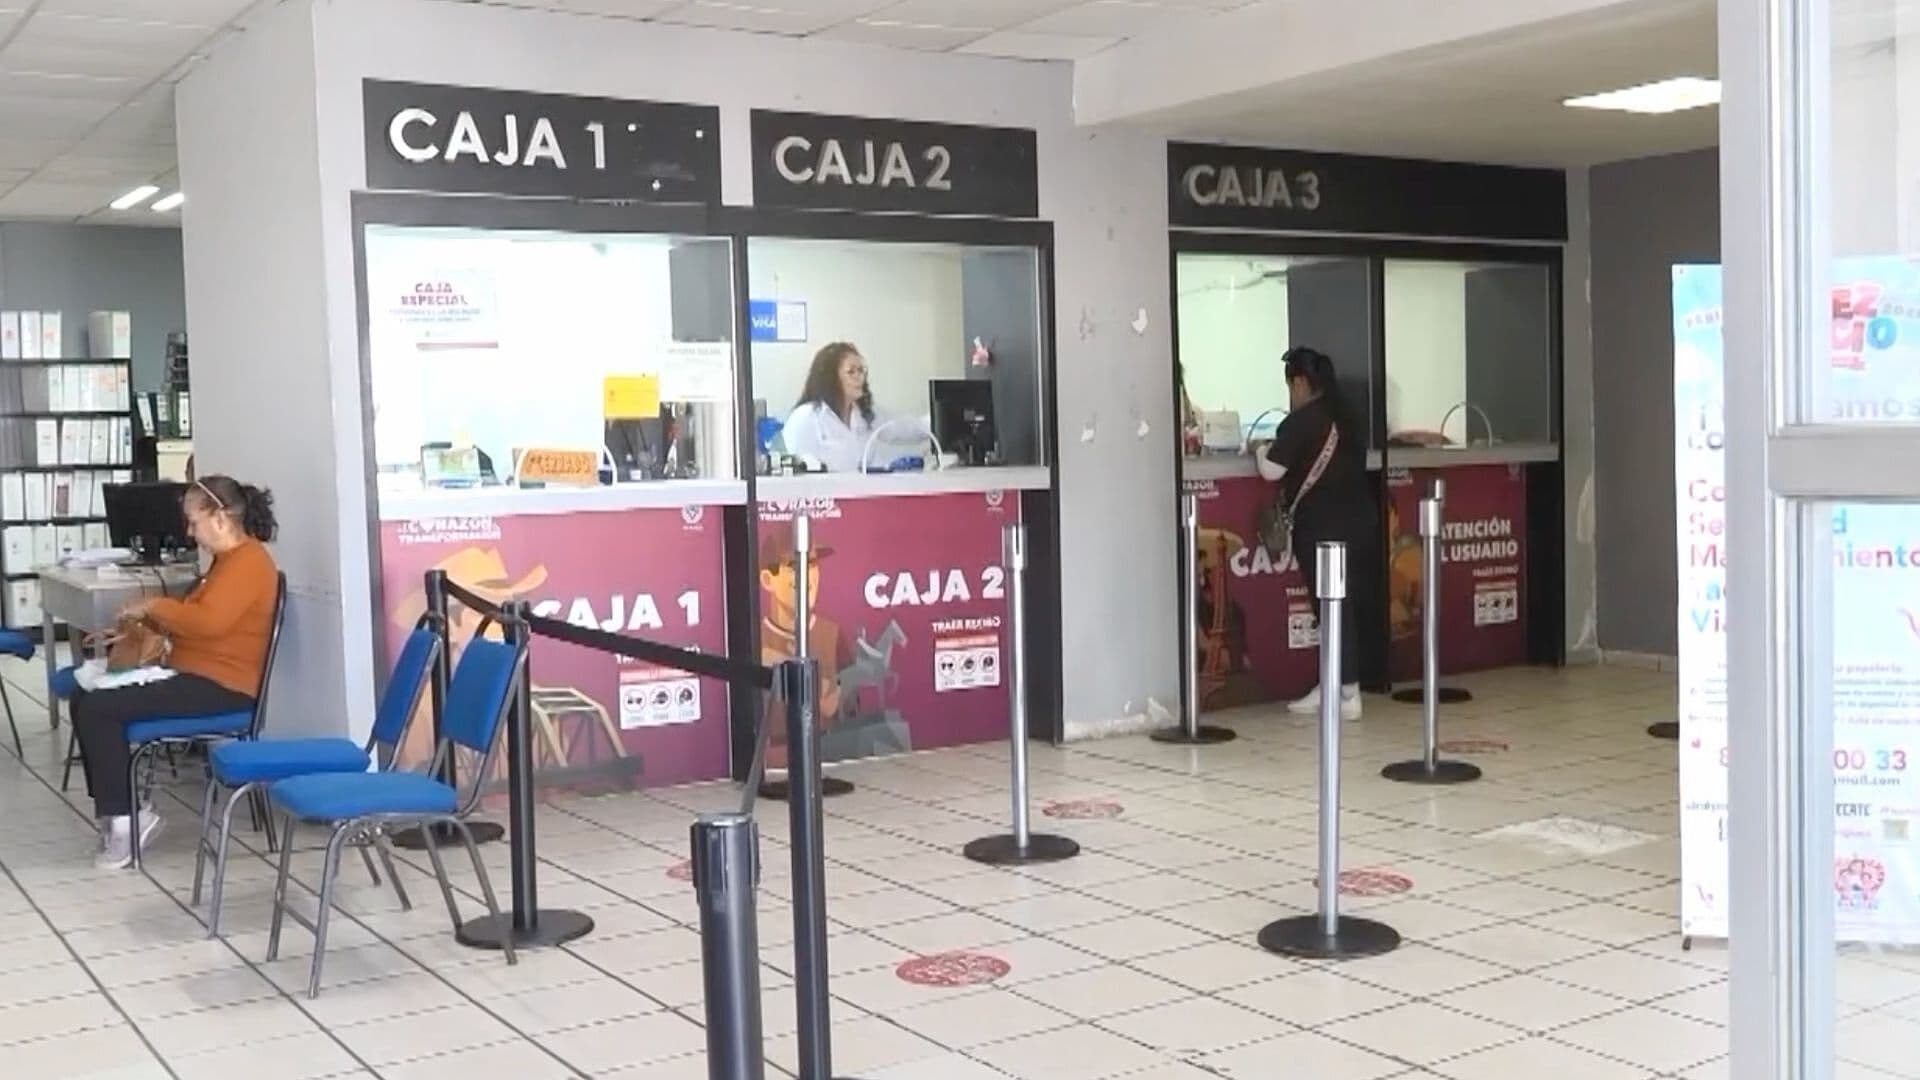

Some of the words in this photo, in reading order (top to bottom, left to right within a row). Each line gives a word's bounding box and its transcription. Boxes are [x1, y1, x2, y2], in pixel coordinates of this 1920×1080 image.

[388, 107, 567, 170] CAJA
[584, 120, 607, 170] 1
[775, 136, 917, 188] CAJA
[924, 145, 952, 192] 2
[1186, 164, 1293, 208] CAJA
[1297, 170, 1321, 211] 3
[1451, 539, 1519, 562] USUARIO
[677, 591, 700, 627] 1
[864, 569, 971, 609] CAJA
[981, 565, 1005, 600] 2
